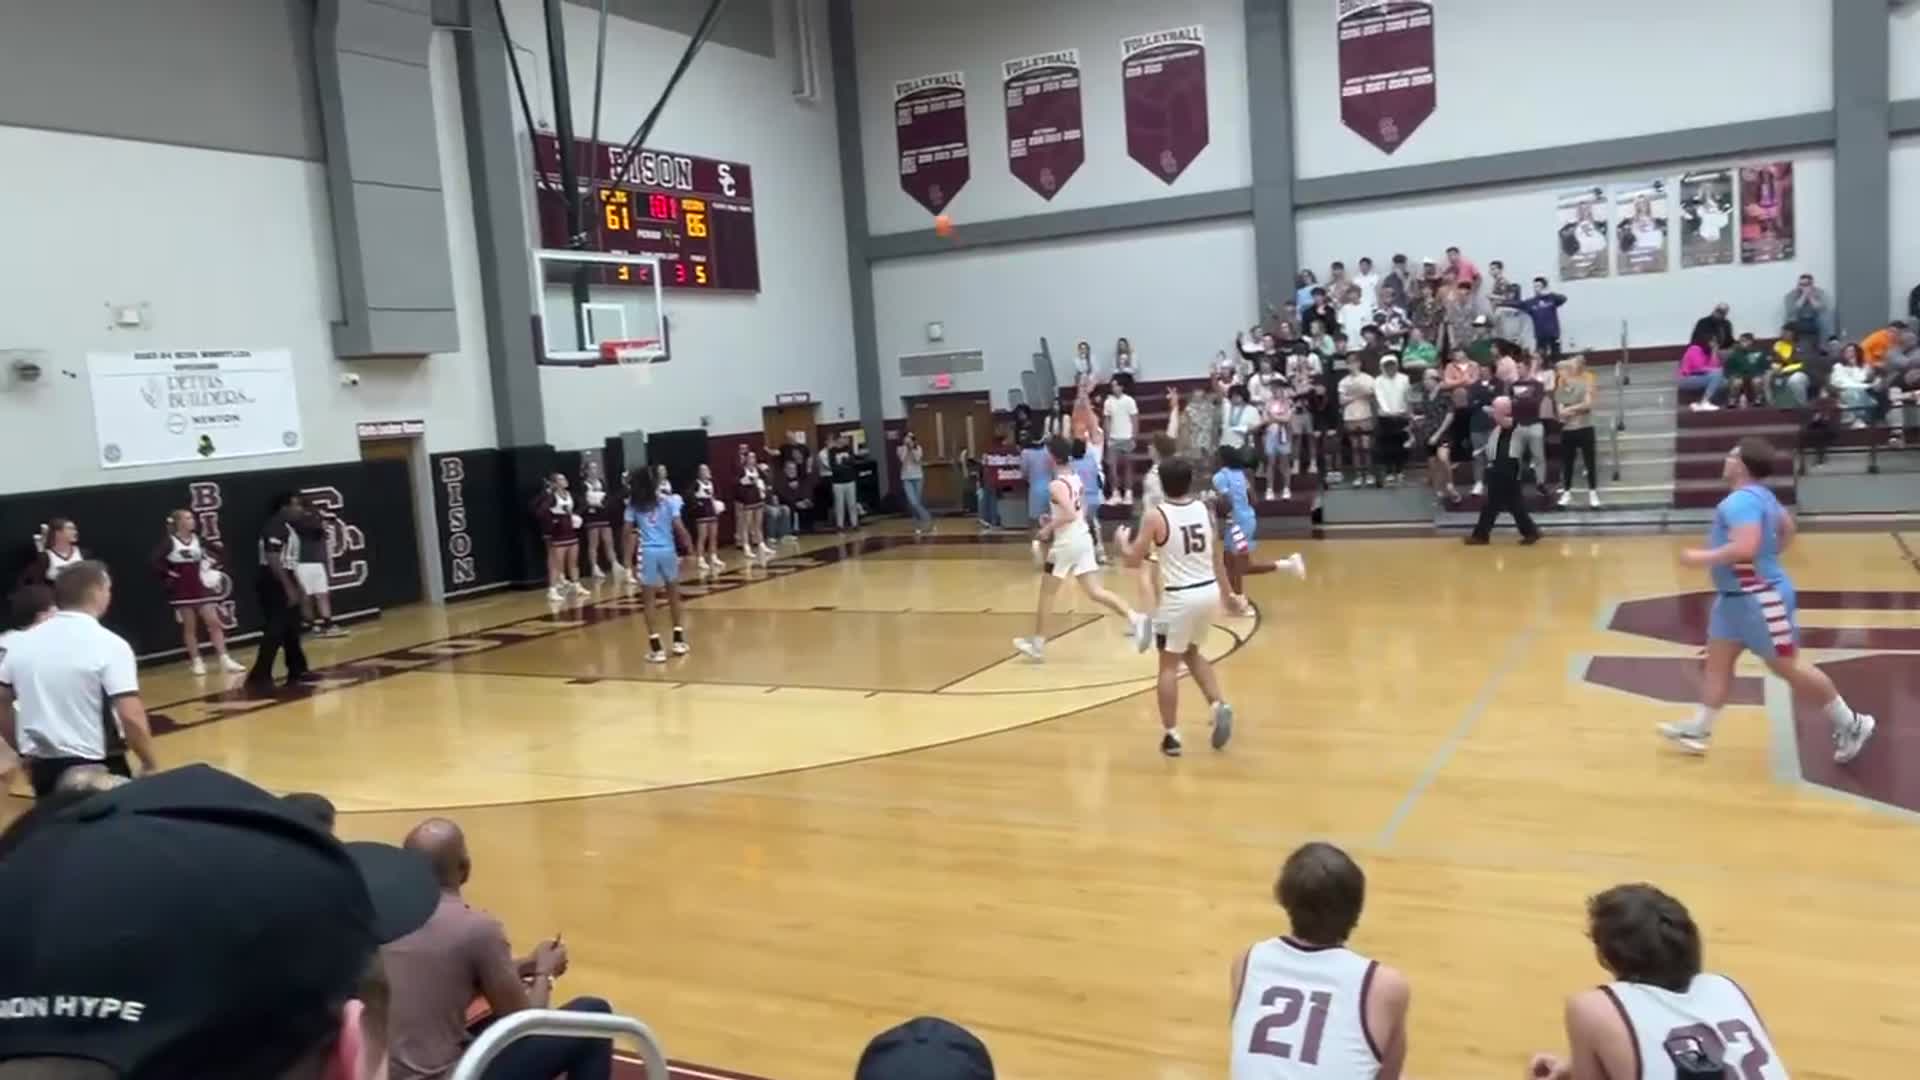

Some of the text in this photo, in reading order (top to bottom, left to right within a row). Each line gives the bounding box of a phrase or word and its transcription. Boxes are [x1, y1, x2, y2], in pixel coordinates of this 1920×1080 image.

[604, 204, 630, 231] 61
[440, 457, 475, 585] BISON
[1180, 523, 1206, 555] 15
[54, 995, 147, 1022] HYPE
[1248, 986, 1333, 1066] 21
